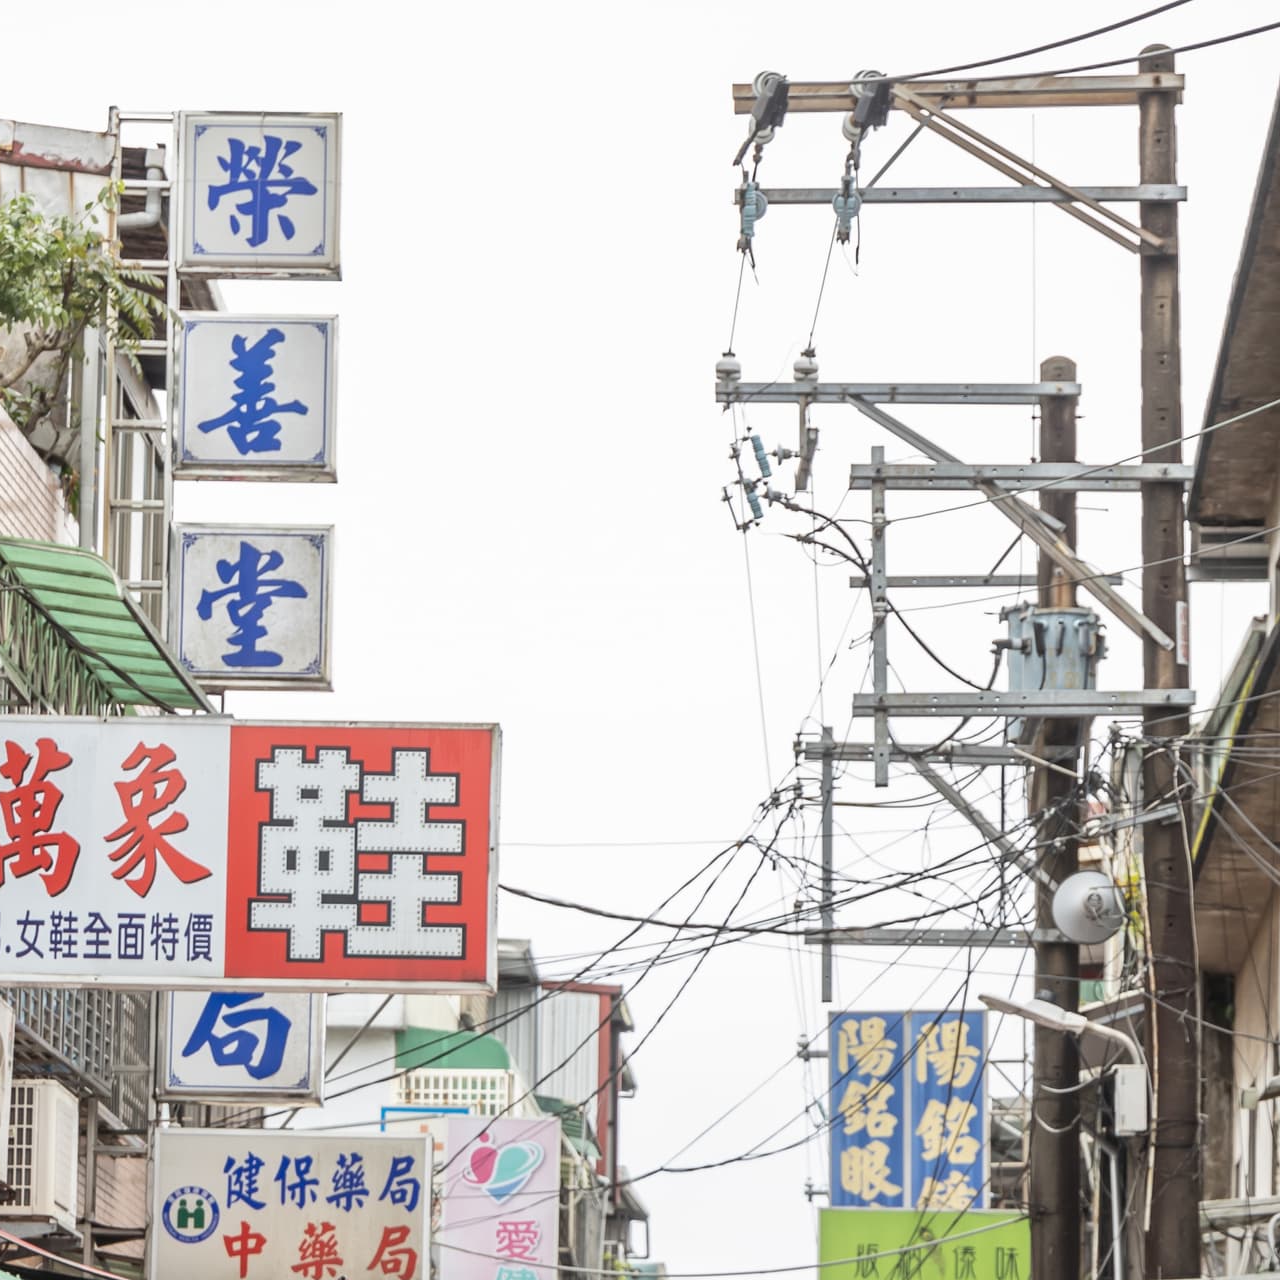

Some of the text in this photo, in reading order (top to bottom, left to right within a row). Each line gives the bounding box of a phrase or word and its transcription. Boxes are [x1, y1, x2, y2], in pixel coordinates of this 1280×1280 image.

[248, 745, 467, 963] 鞋
[182, 992, 293, 1081] 局
[223, 1151, 422, 1213] 健保藥局
[853, 1243, 1020, 1280] 版納傣味
